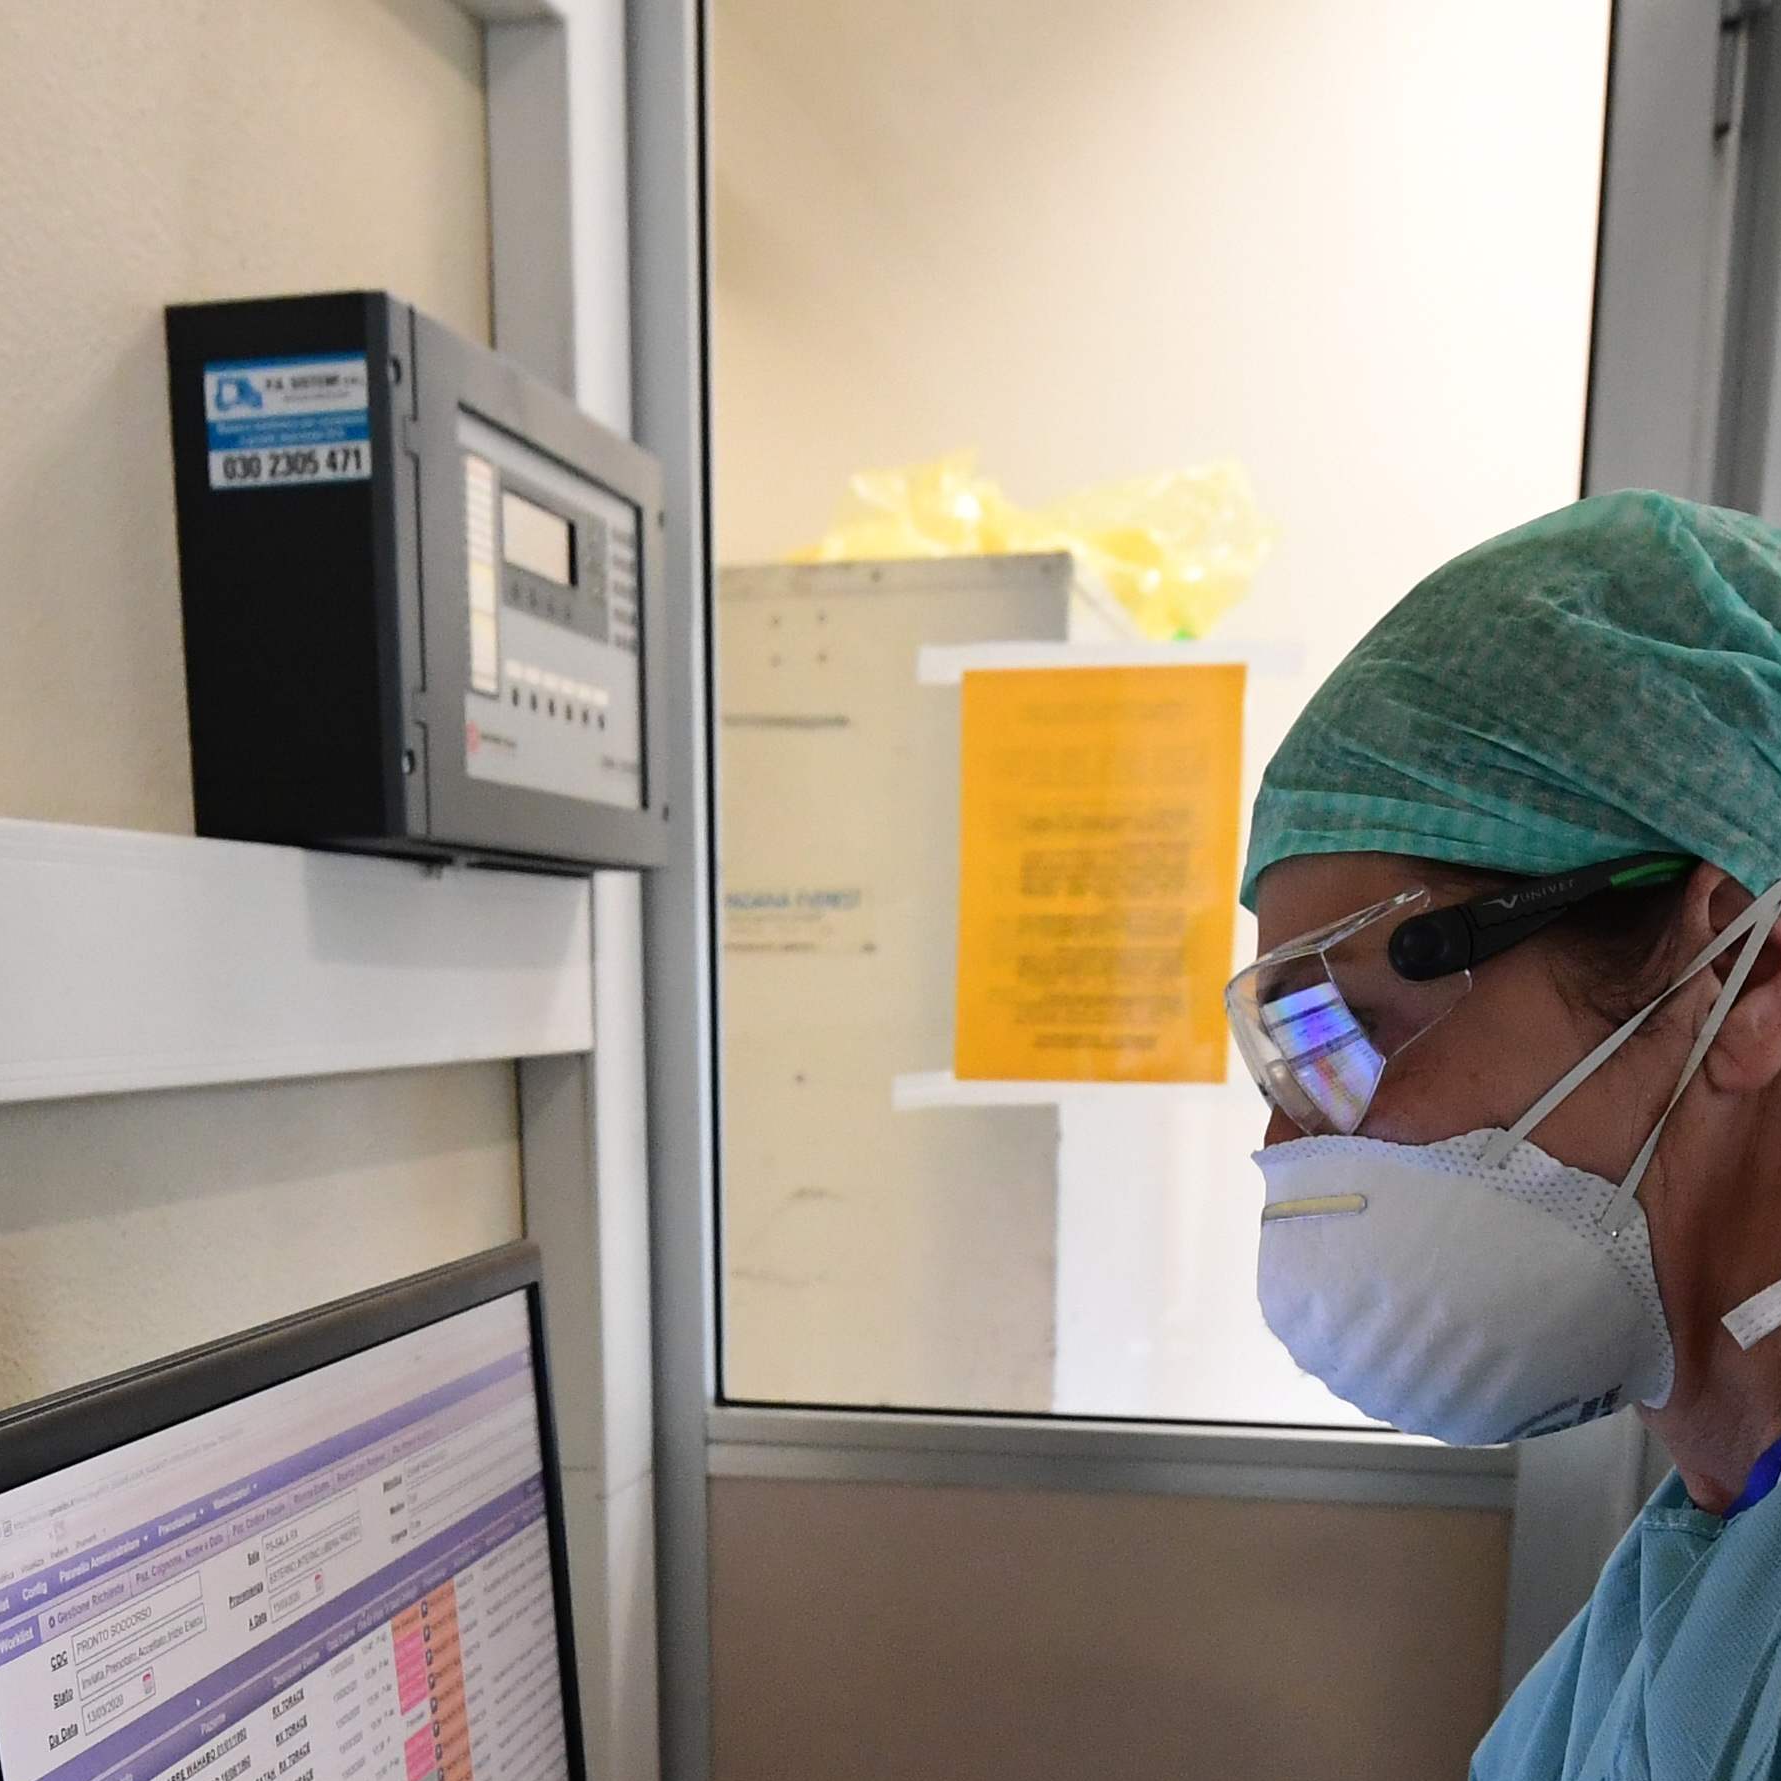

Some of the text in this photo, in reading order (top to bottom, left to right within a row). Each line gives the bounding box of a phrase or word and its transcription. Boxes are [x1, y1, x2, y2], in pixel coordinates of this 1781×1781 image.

[222, 446, 362, 480] 030 2305 471
[21, 1578, 48, 1604] Config
[57, 1596, 90, 1625] Gestione
[76, 1604, 152, 1656] PRONTO SOCCORSO
[50, 1649, 68, 1672] CDC
[52, 1684, 74, 1710] Stato
[87, 1693, 124, 1726] 13/03/2020
[281, 1687, 304, 1713] TORACE
[48, 1720, 79, 1752] Da Data
[284, 1714, 307, 1741] TORACE
[288, 1740, 310, 1768] TORACE
